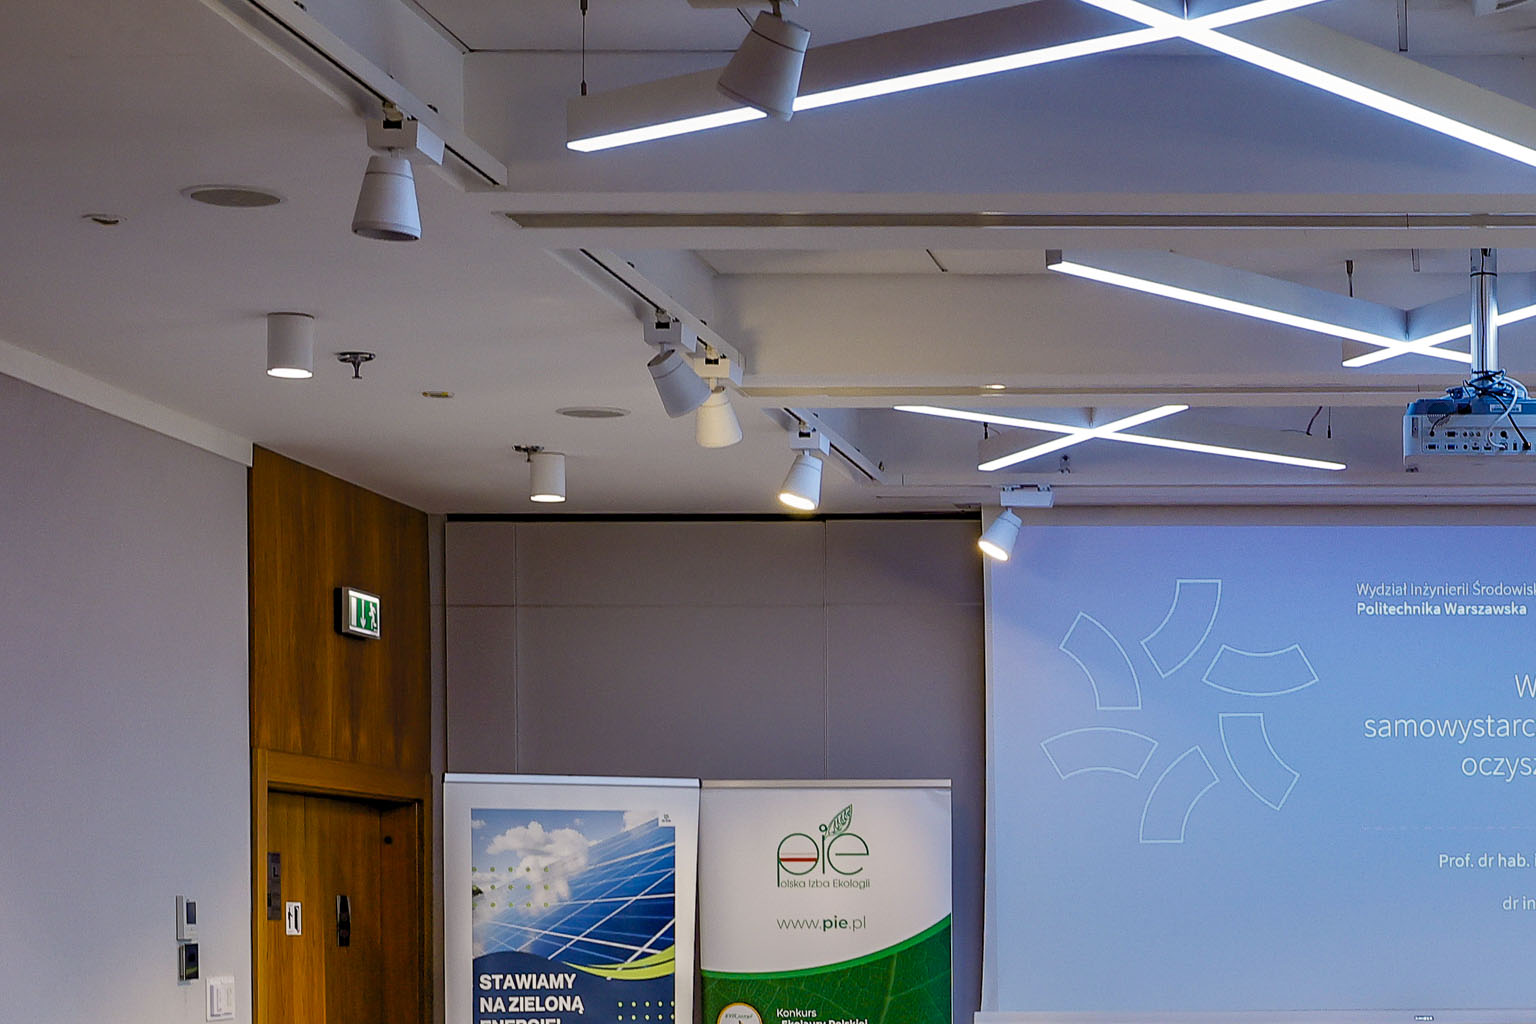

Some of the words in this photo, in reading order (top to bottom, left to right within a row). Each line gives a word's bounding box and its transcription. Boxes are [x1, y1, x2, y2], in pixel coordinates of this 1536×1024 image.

[1357, 583, 1407, 598] Wydział
[1410, 583, 1469, 598] Inżynierii
[1357, 601, 1441, 615] Politechnika
[1444, 601, 1526, 615] Warszawska
[1439, 854, 1474, 868] Prof.
[1479, 854, 1494, 867] dr
[1498, 854, 1529, 867] hab.
[809, 880, 829, 888] Izba
[833, 879, 870, 890] Ekologii
[1503, 896, 1518, 910] dr
[777, 915, 866, 932] www.pie.pl
[479, 973, 576, 991] STAWIAMY
[480, 997, 505, 1013] NA
[509, 996, 584, 1014] ZIELONĄ
[777, 1008, 817, 1018] Konkurs
